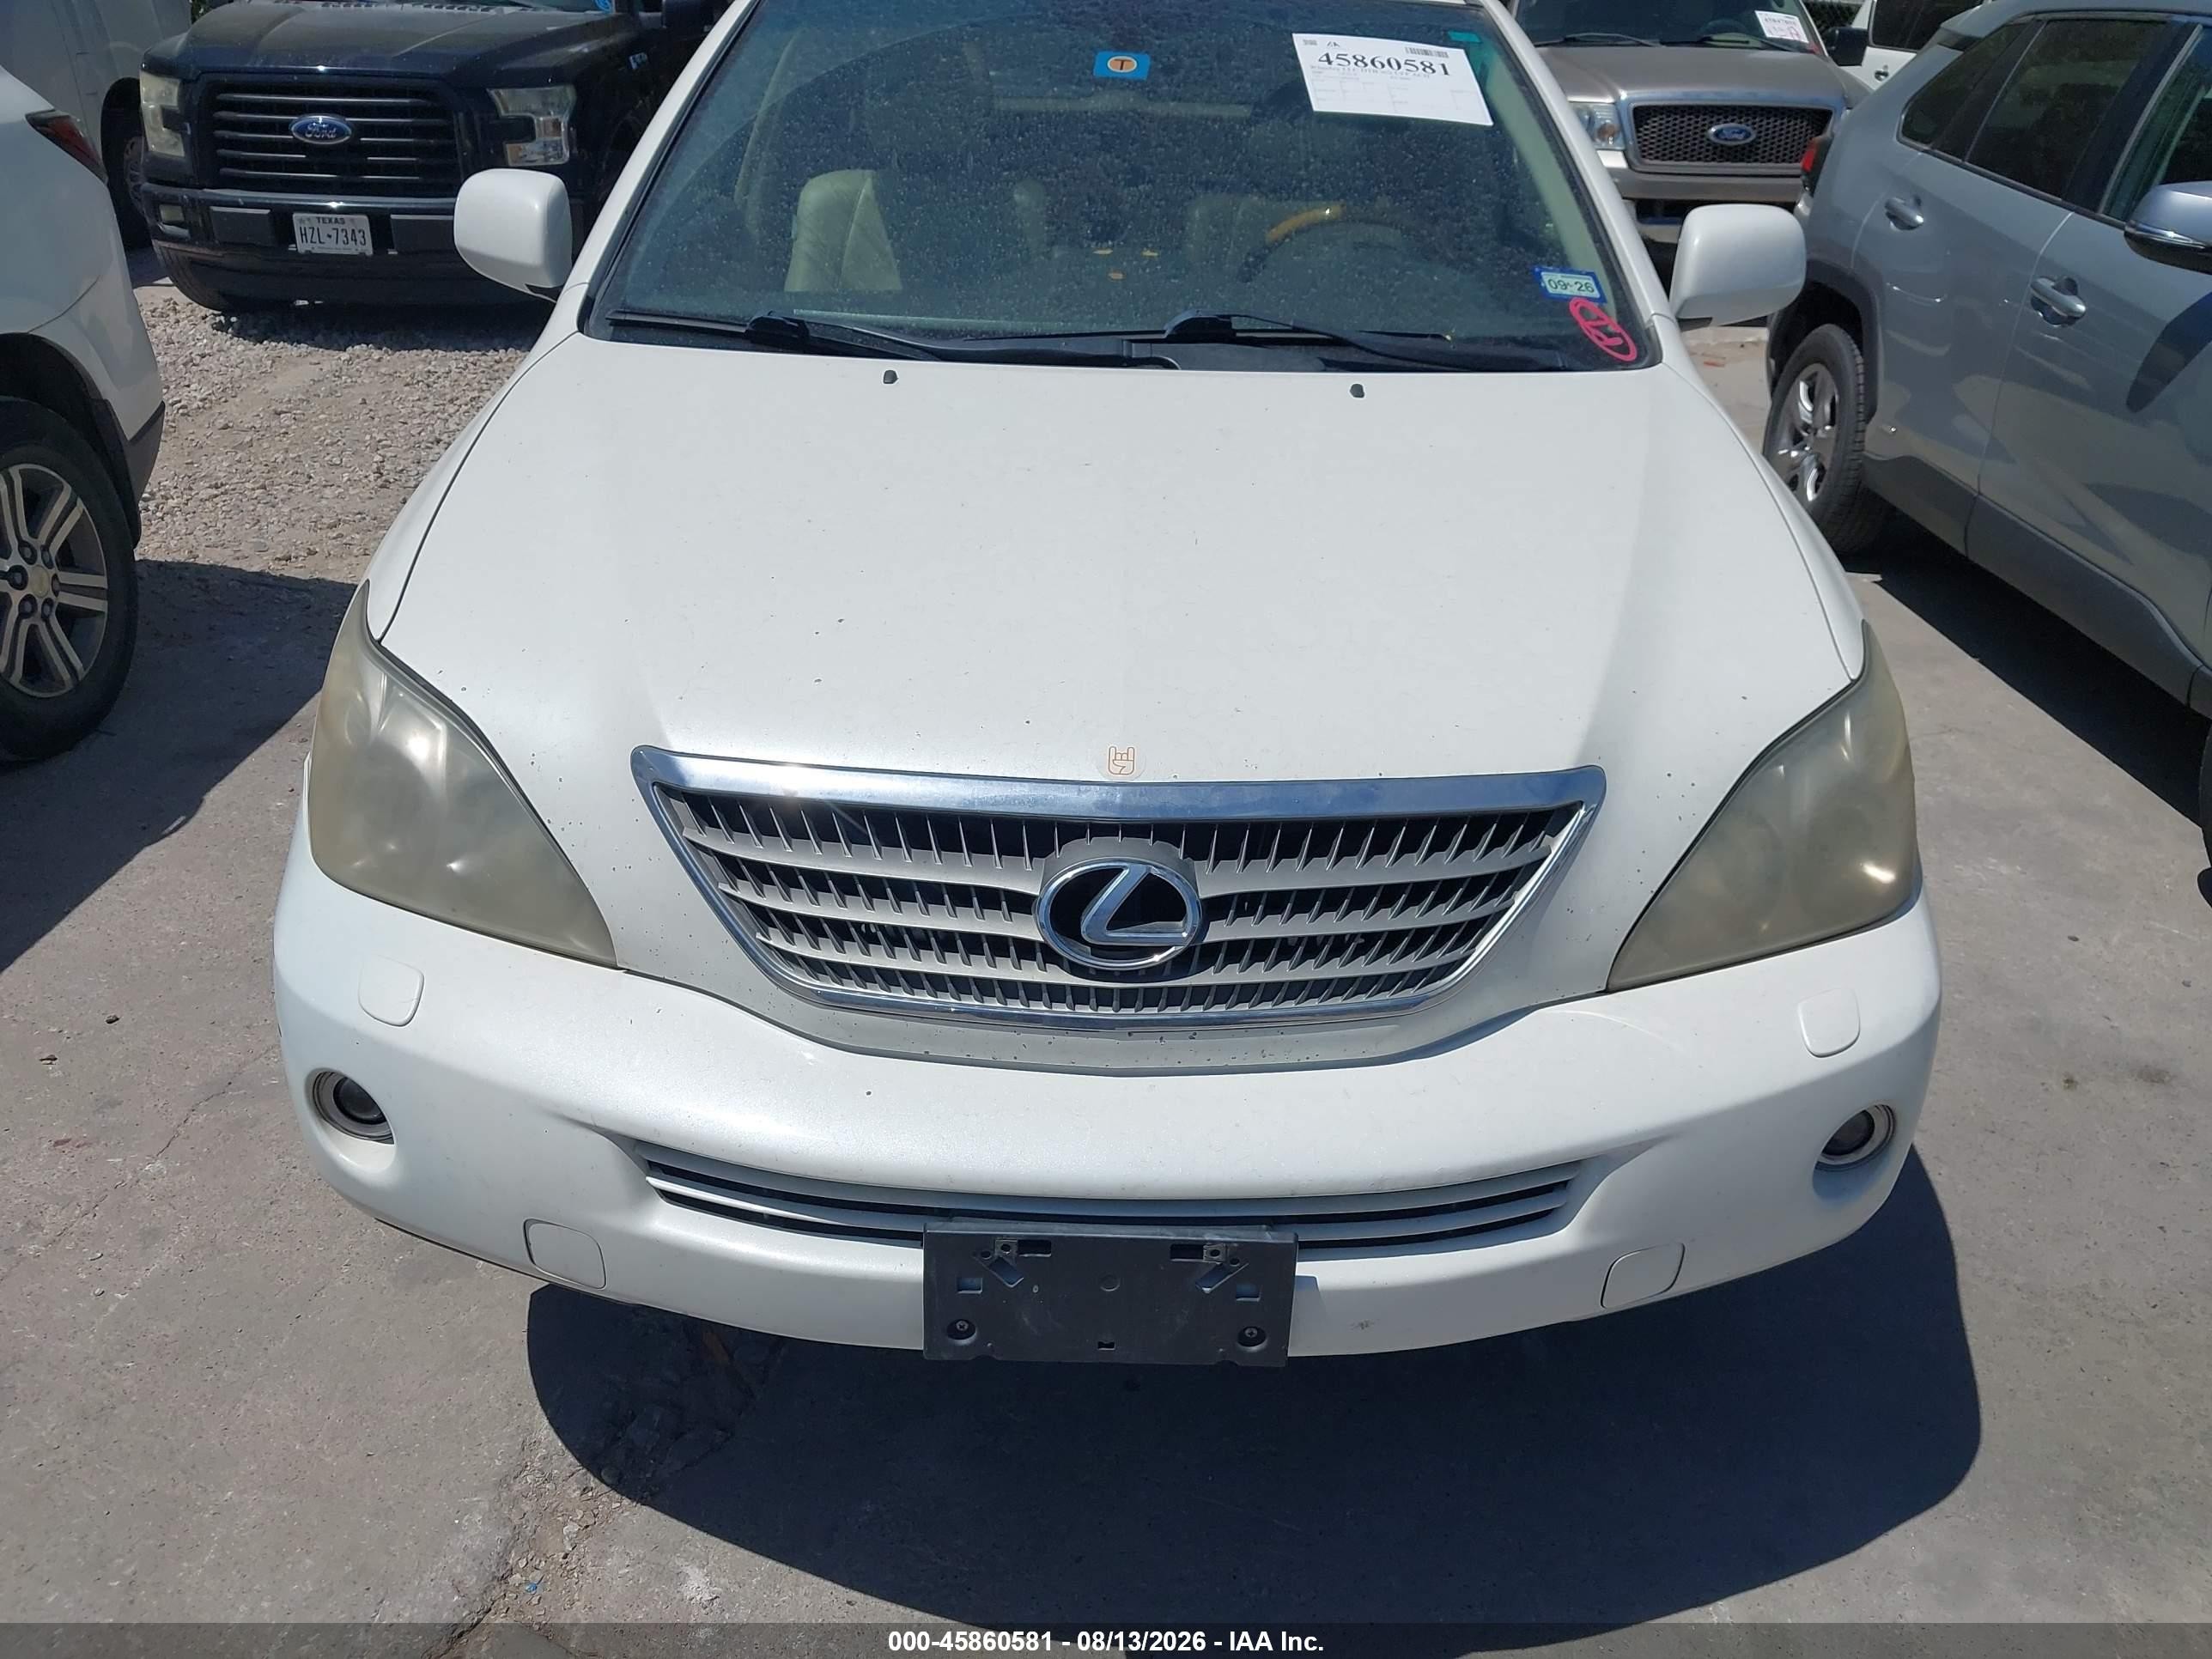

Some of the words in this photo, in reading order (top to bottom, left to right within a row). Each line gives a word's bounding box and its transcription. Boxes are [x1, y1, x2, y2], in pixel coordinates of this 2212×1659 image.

[1113, 58, 1133, 70] T
[1317, 52, 1451, 76] 45860581
[305, 122, 337, 138] Ford
[316, 216, 346, 225] TEXAS
